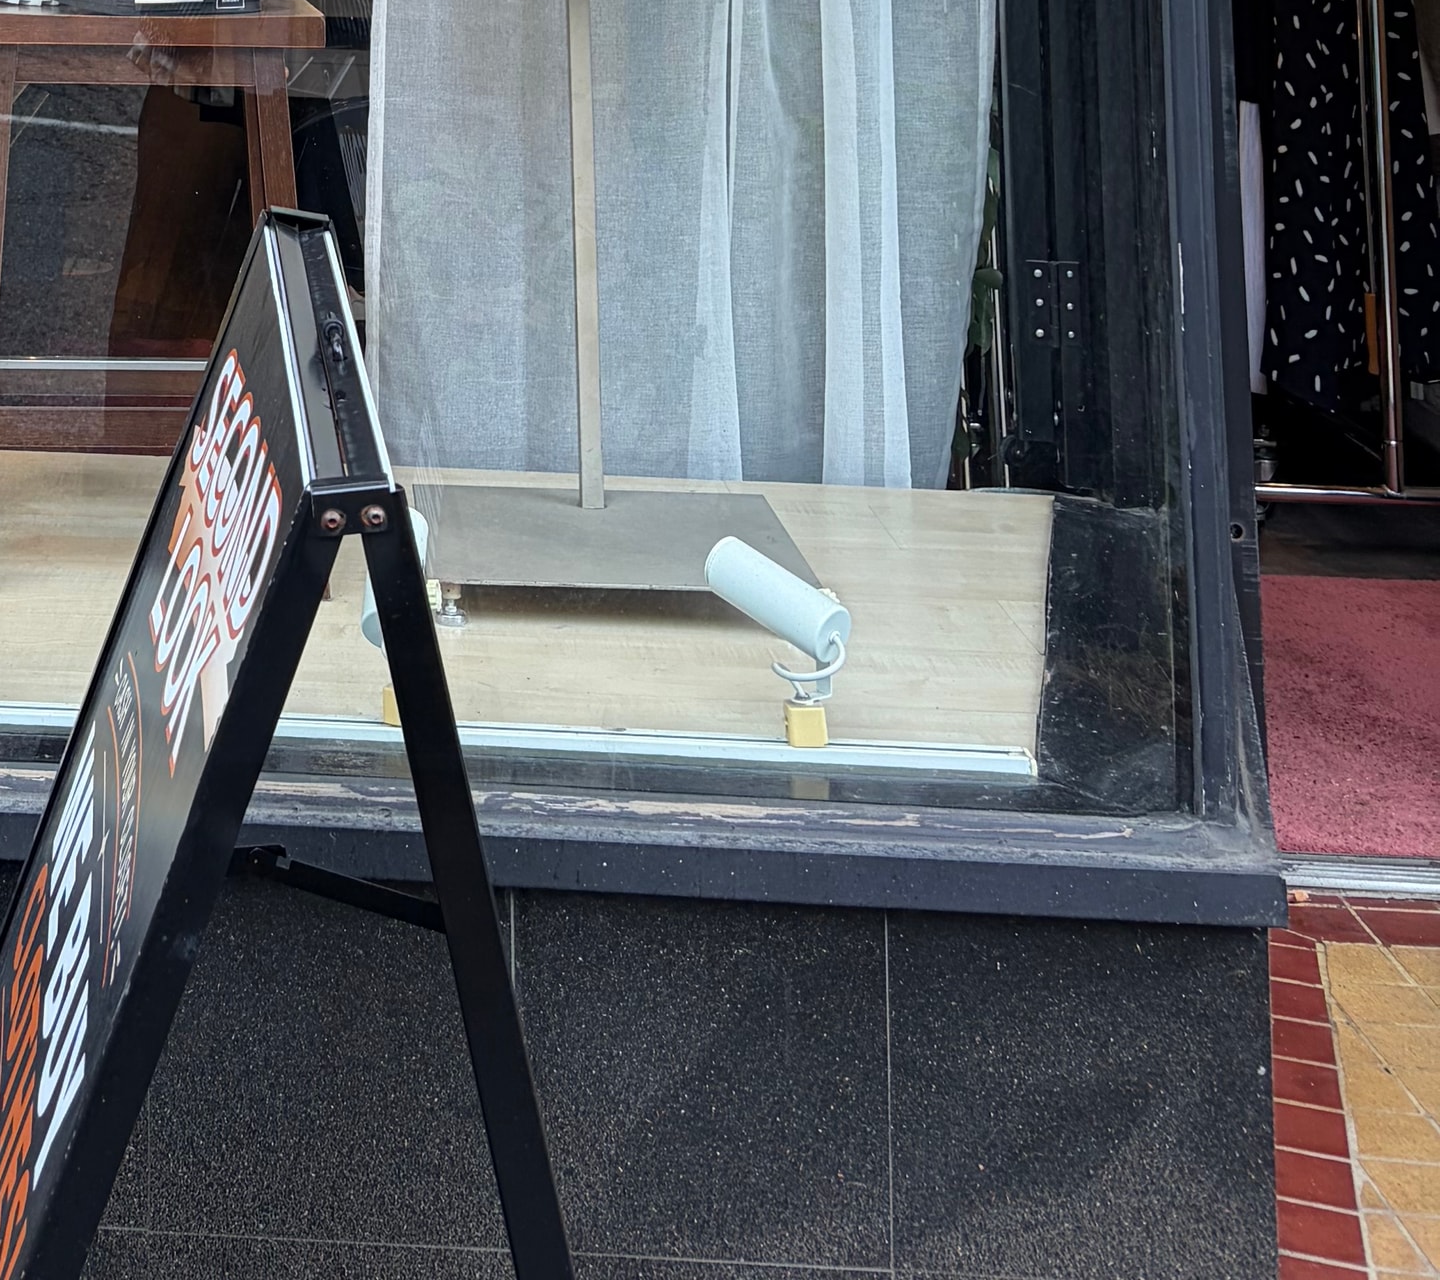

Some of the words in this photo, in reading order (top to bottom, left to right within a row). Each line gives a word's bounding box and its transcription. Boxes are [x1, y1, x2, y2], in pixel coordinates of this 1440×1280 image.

[191, 348, 283, 640] SECOND
[150, 511, 221, 778] LOOK
[46, 719, 96, 961] WE
[33, 871, 93, 1191] BUY
